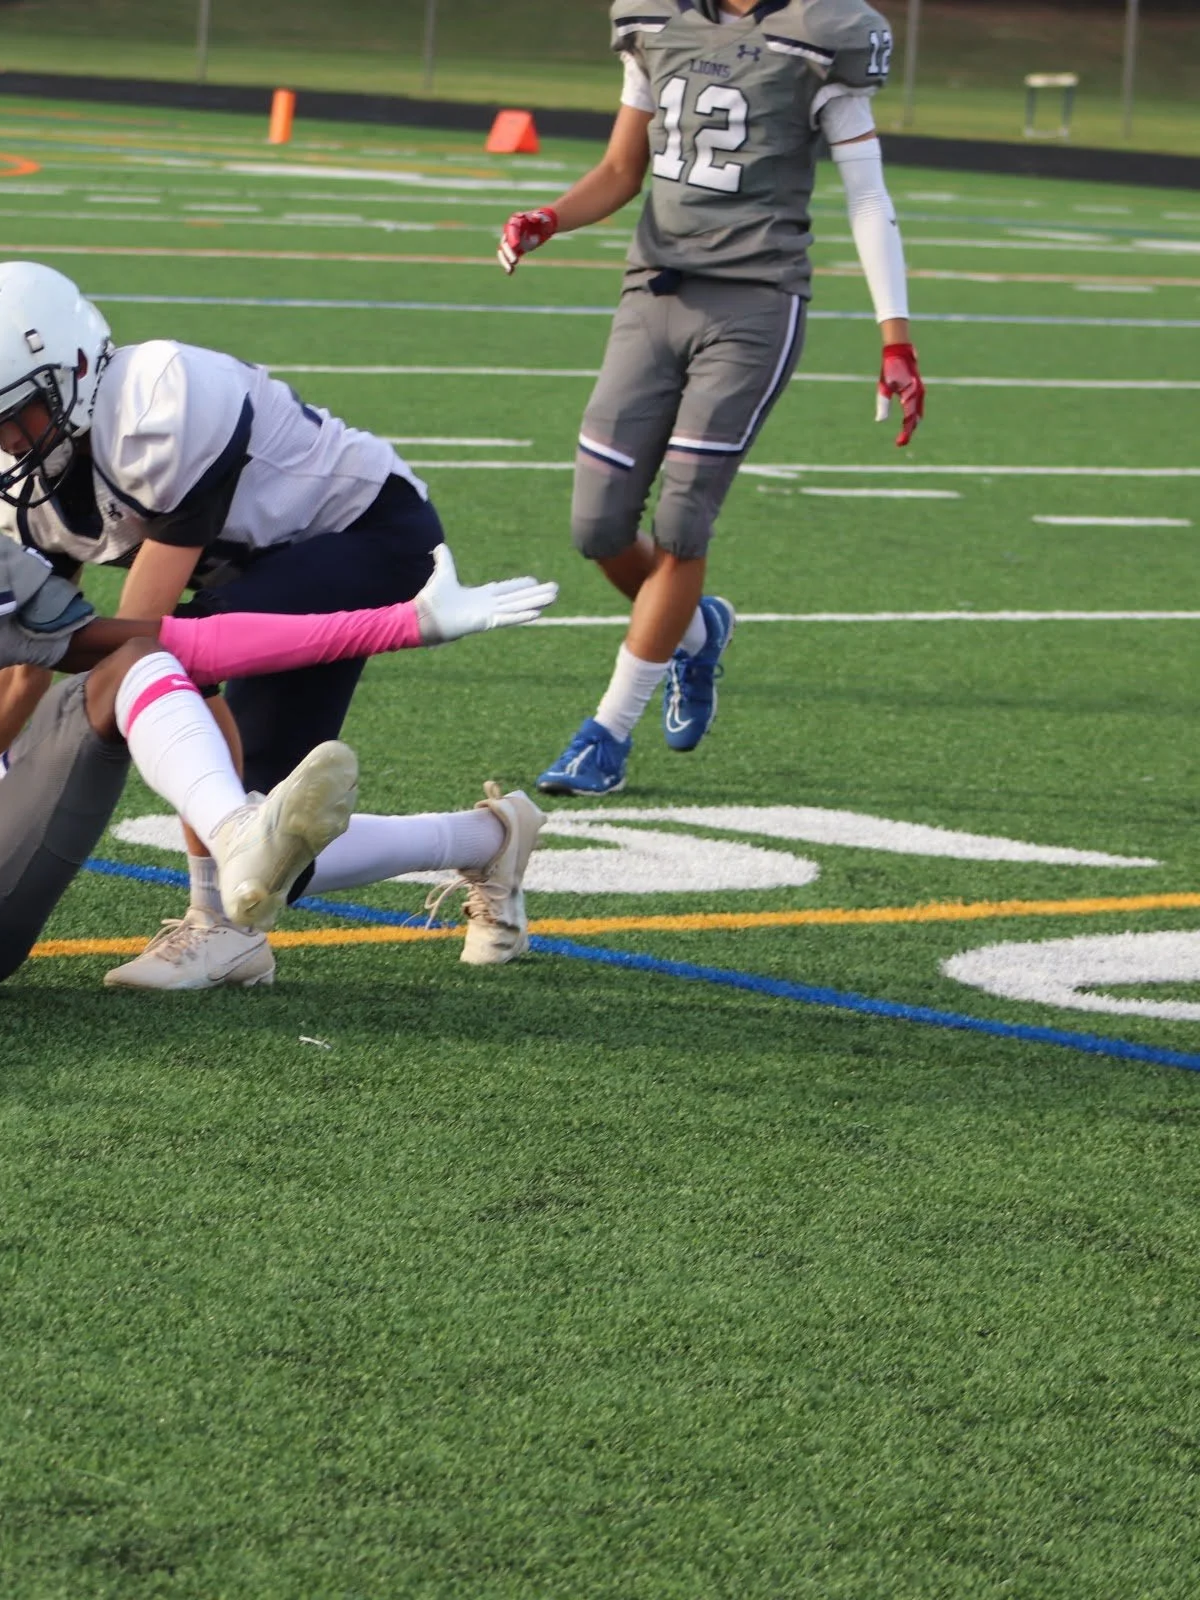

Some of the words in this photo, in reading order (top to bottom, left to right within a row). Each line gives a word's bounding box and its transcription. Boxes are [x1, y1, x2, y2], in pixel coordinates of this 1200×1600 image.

[689, 58, 731, 79] LIONS
[866, 29, 893, 77] 12
[652, 75, 748, 193] 12
